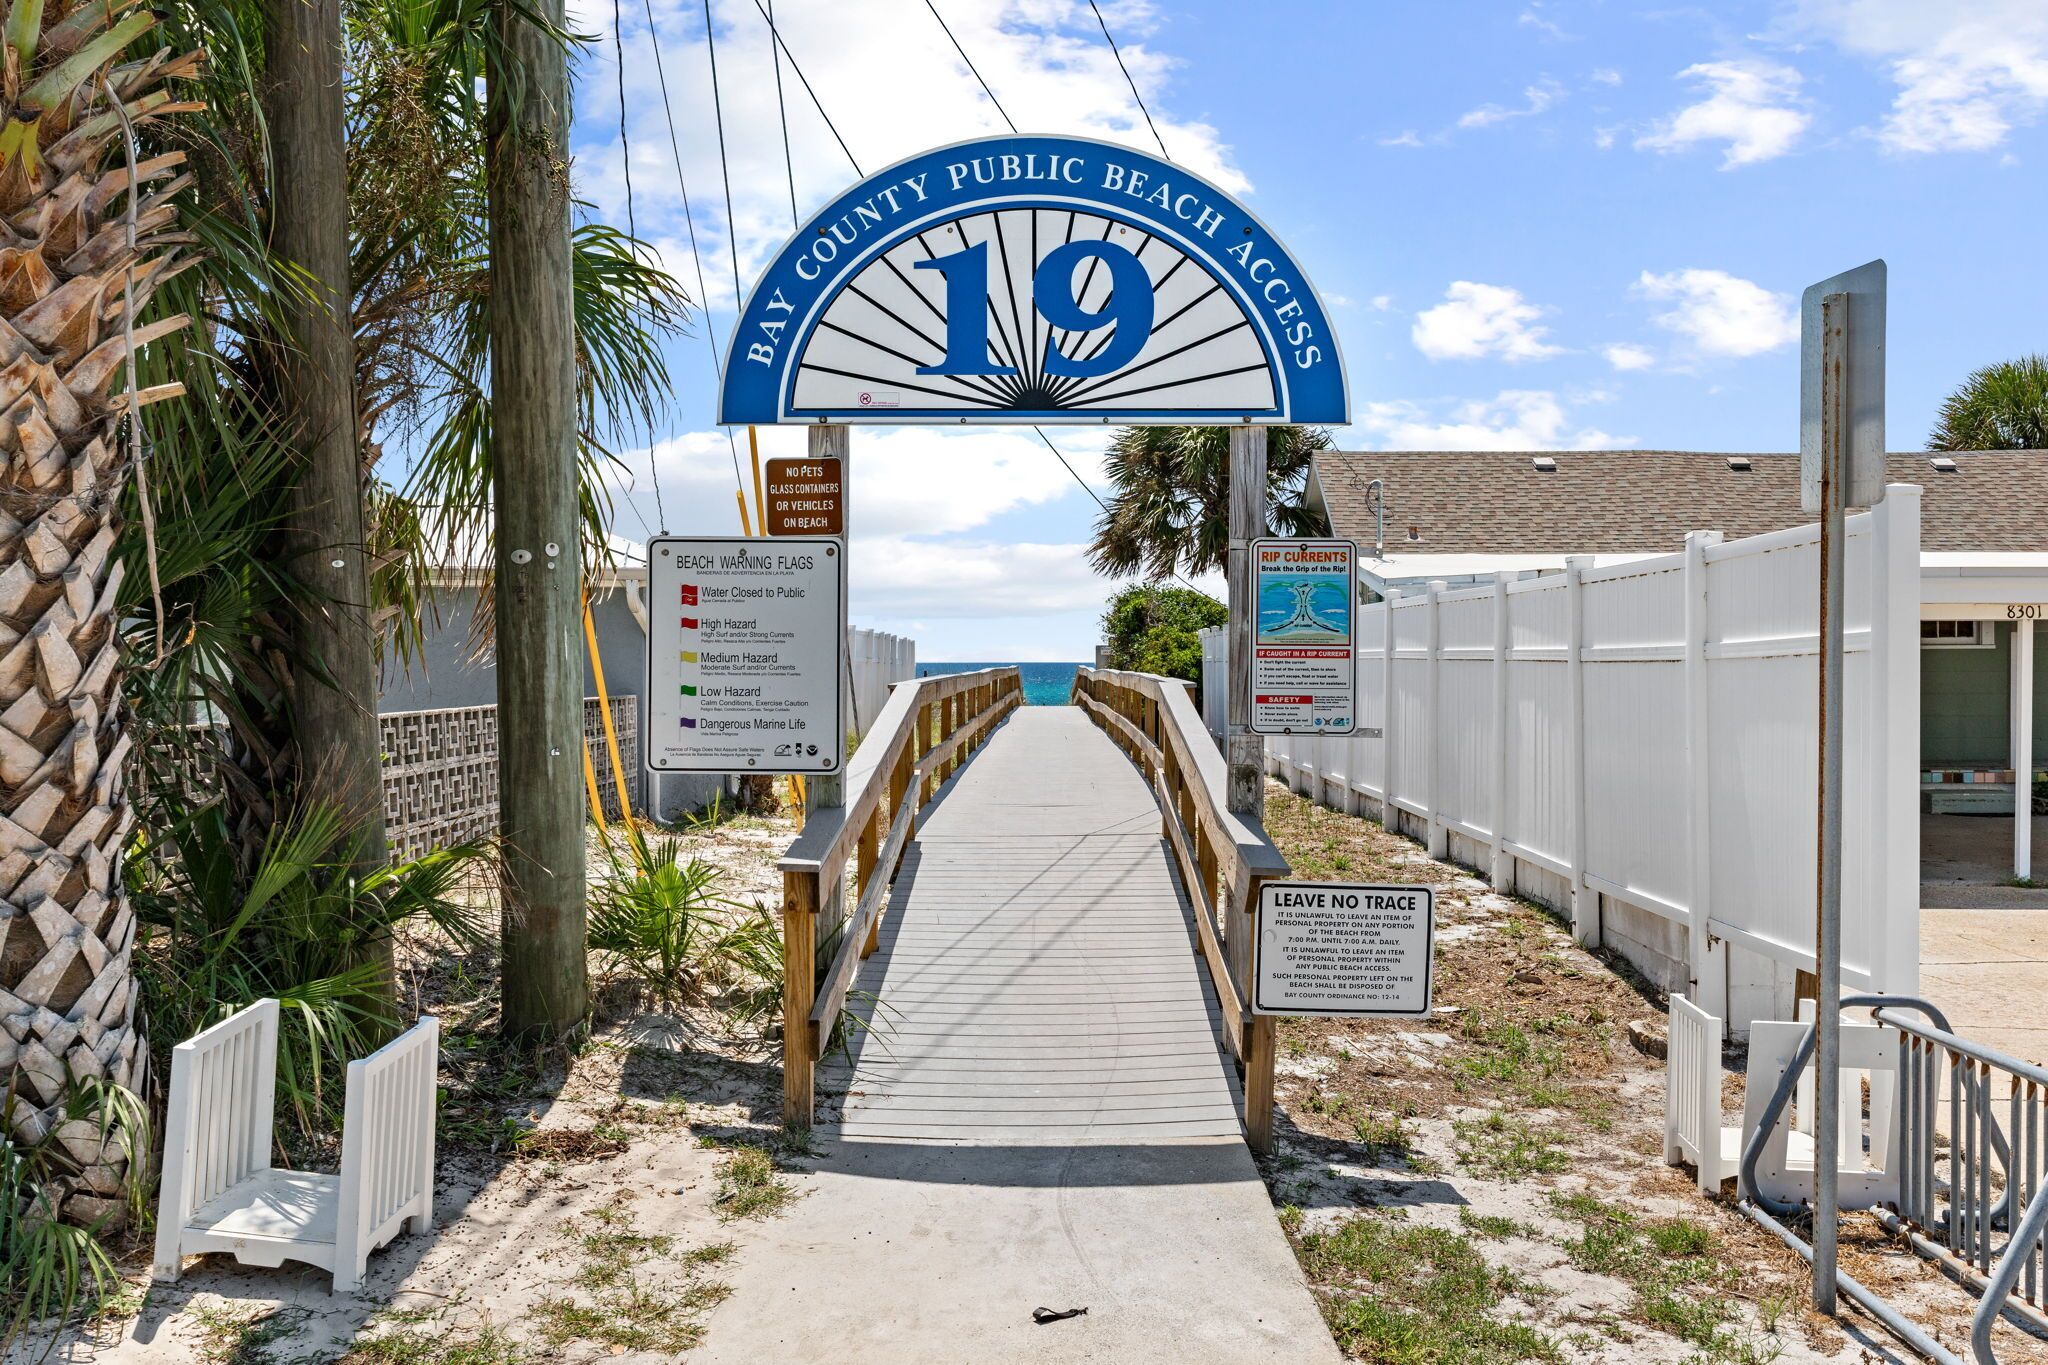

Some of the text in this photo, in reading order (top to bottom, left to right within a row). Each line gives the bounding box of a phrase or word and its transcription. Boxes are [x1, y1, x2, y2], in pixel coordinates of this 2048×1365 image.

[746, 154, 1323, 370] BAY COUNTY PUBLIC BEACH ACCESS
[914, 239, 1155, 378] 19
[786, 466, 823, 477] NO PETS
[770, 483, 839, 494] GLASS CONTAINERS
[776, 500, 834, 511] OR VEHICLES
[784, 517, 828, 528] ON BEACH
[677, 556, 813, 569] BEACH WARNING FLAGS
[1261, 551, 1347, 562] RIP CURRENTS
[702, 586, 805, 598] Water Closed to Public
[2007, 605, 2041, 618] 8301
[701, 619, 757, 631] High Hazard
[701, 652, 778, 663] Medium Hazard
[701, 686, 761, 697] Low Hazard
[701, 718, 806, 731] Dangerous Marine Life
[1275, 893, 1416, 910] LEAVE NO TRACE
